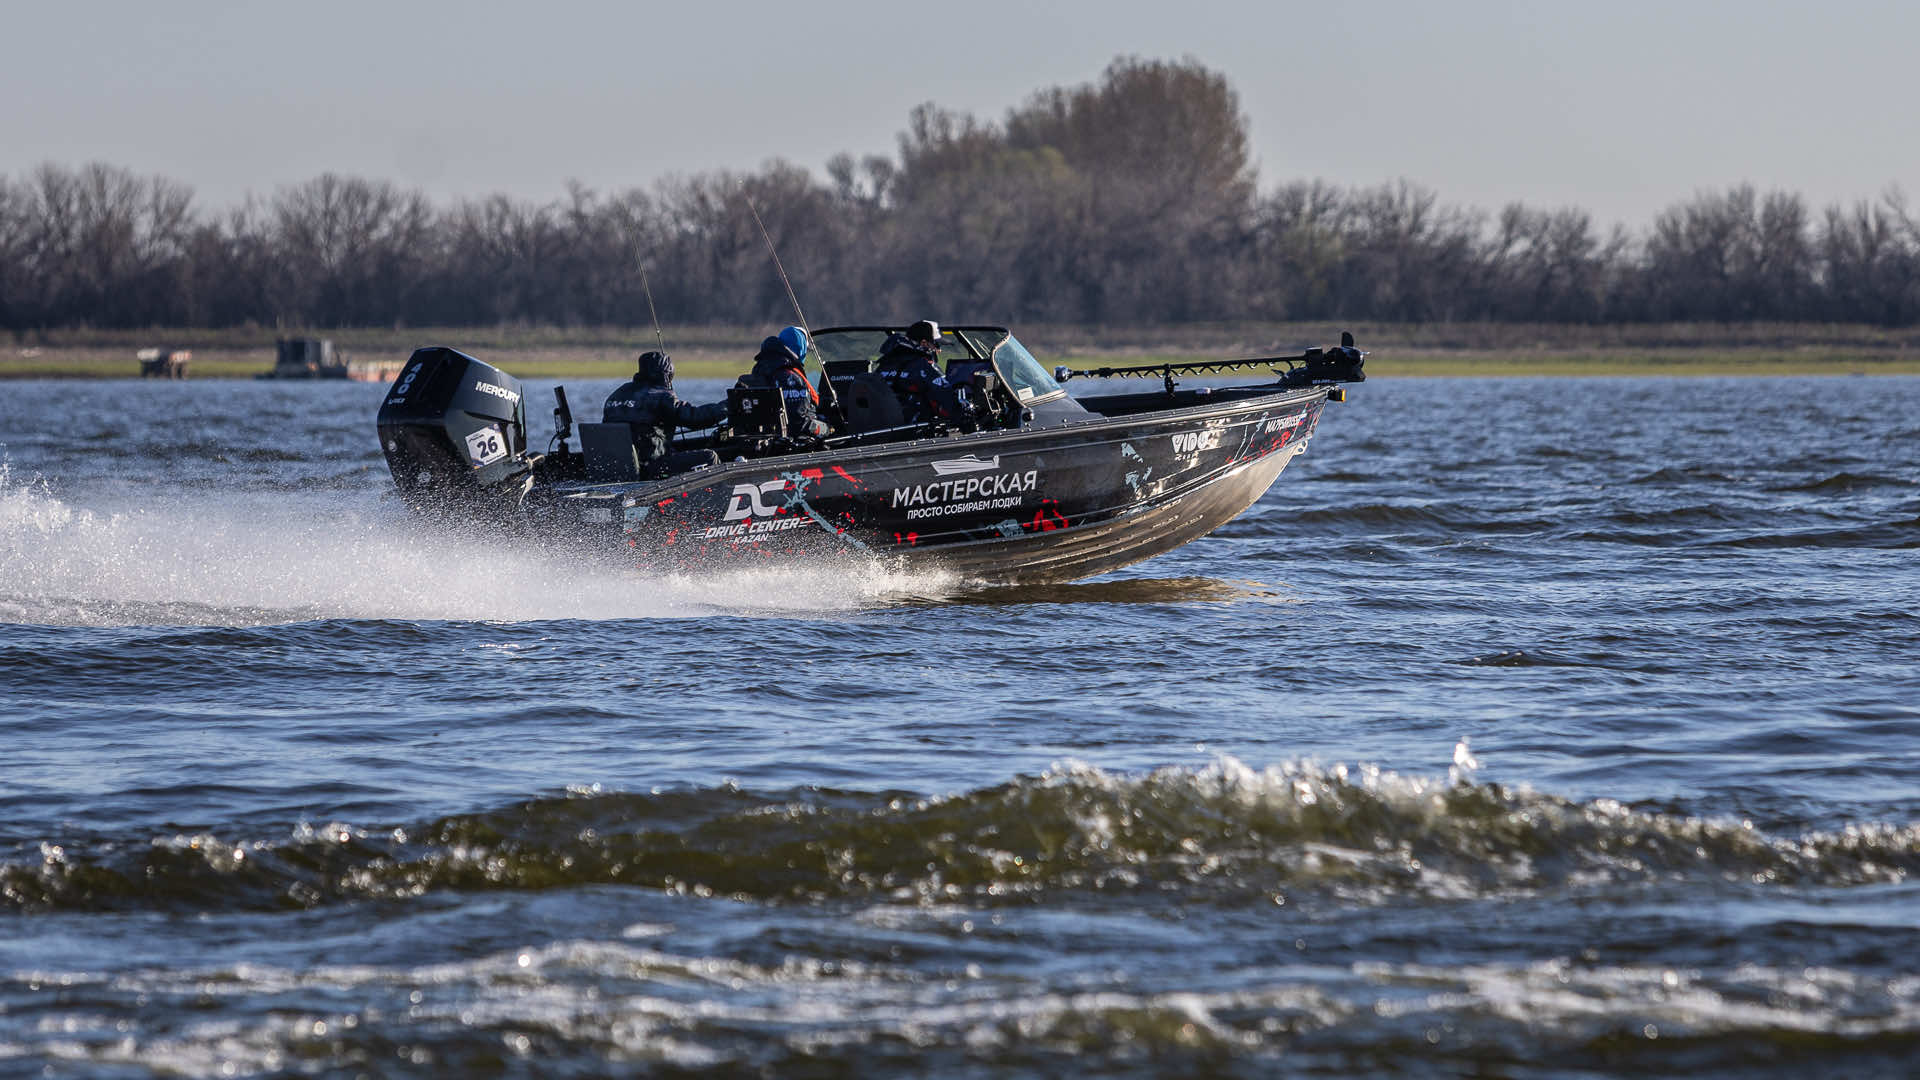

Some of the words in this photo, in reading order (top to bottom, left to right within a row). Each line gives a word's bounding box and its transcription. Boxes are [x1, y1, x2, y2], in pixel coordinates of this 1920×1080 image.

[475, 381, 520, 402] MERCURY
[476, 436, 499, 459] 26
[723, 480, 786, 521] DC
[892, 470, 1037, 508] МАСТЕРСКАЯ
[907, 506, 943, 520] ПРОСТО
[944, 500, 990, 515] СОБИРАЕМ
[991, 496, 1022, 510] ЛОДКИ
[705, 523, 748, 539] DRIVE
[748, 517, 801, 534] CENTER
[732, 533, 769, 545] KAZAN
